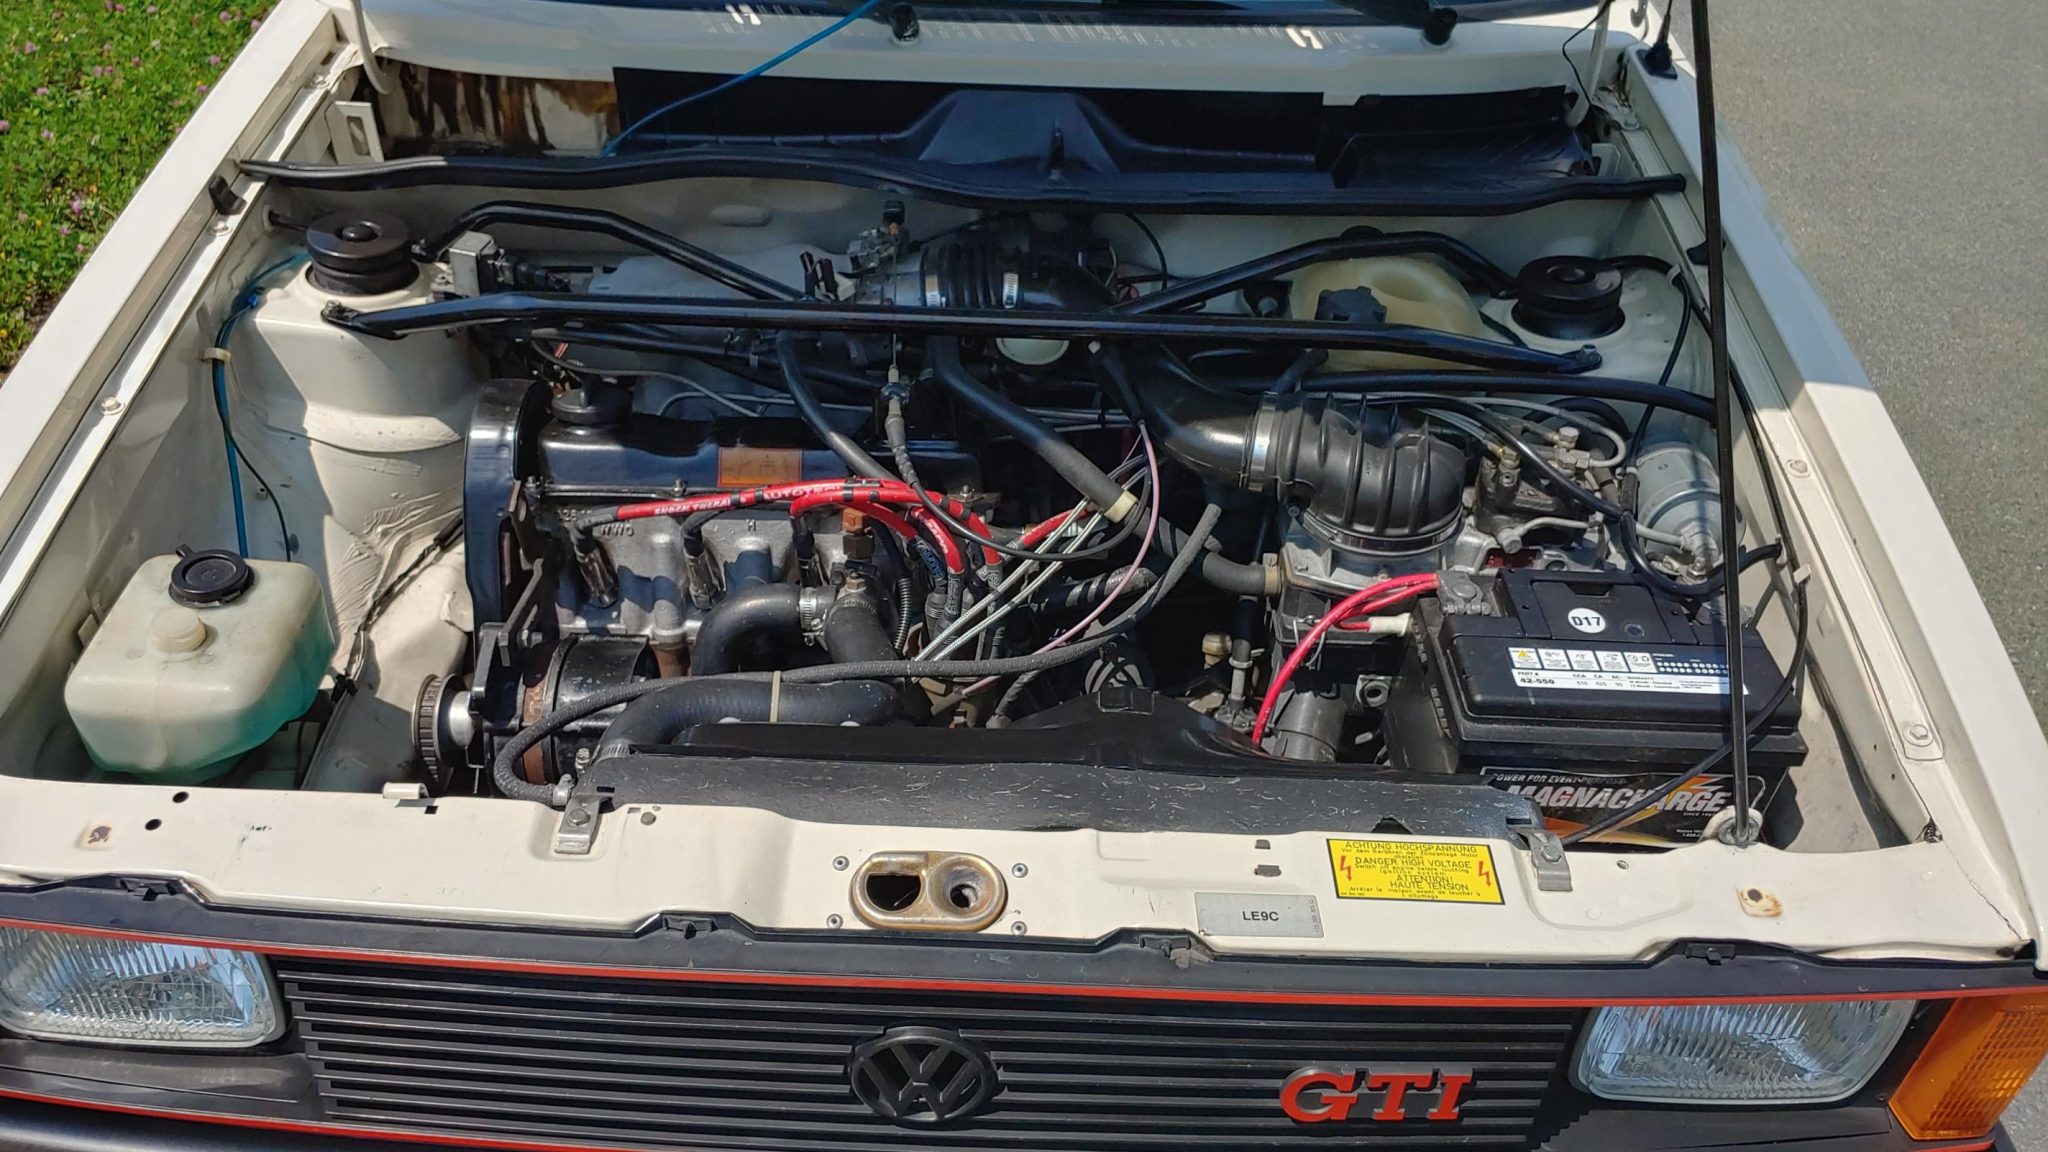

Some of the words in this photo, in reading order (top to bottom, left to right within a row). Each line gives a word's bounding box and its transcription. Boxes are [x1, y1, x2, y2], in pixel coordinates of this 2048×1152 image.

[654, 504, 690, 516] SHOCK
[1571, 614, 1601, 626] D17
[1527, 774, 1547, 783] FOR
[1345, 841, 1392, 850] ACHTUNG
[1396, 844, 1477, 853] HOCHSPANNUNG
[1355, 856, 1397, 866] DANGER
[1401, 858, 1425, 867] HIGH
[1428, 859, 1472, 868] VOLTAGE
[1390, 880, 1425, 889] HAUTE
[1428, 882, 1469, 891] TENSION
[1242, 910, 1280, 921] LE9C
[1280, 1067, 1472, 1123] GTI
